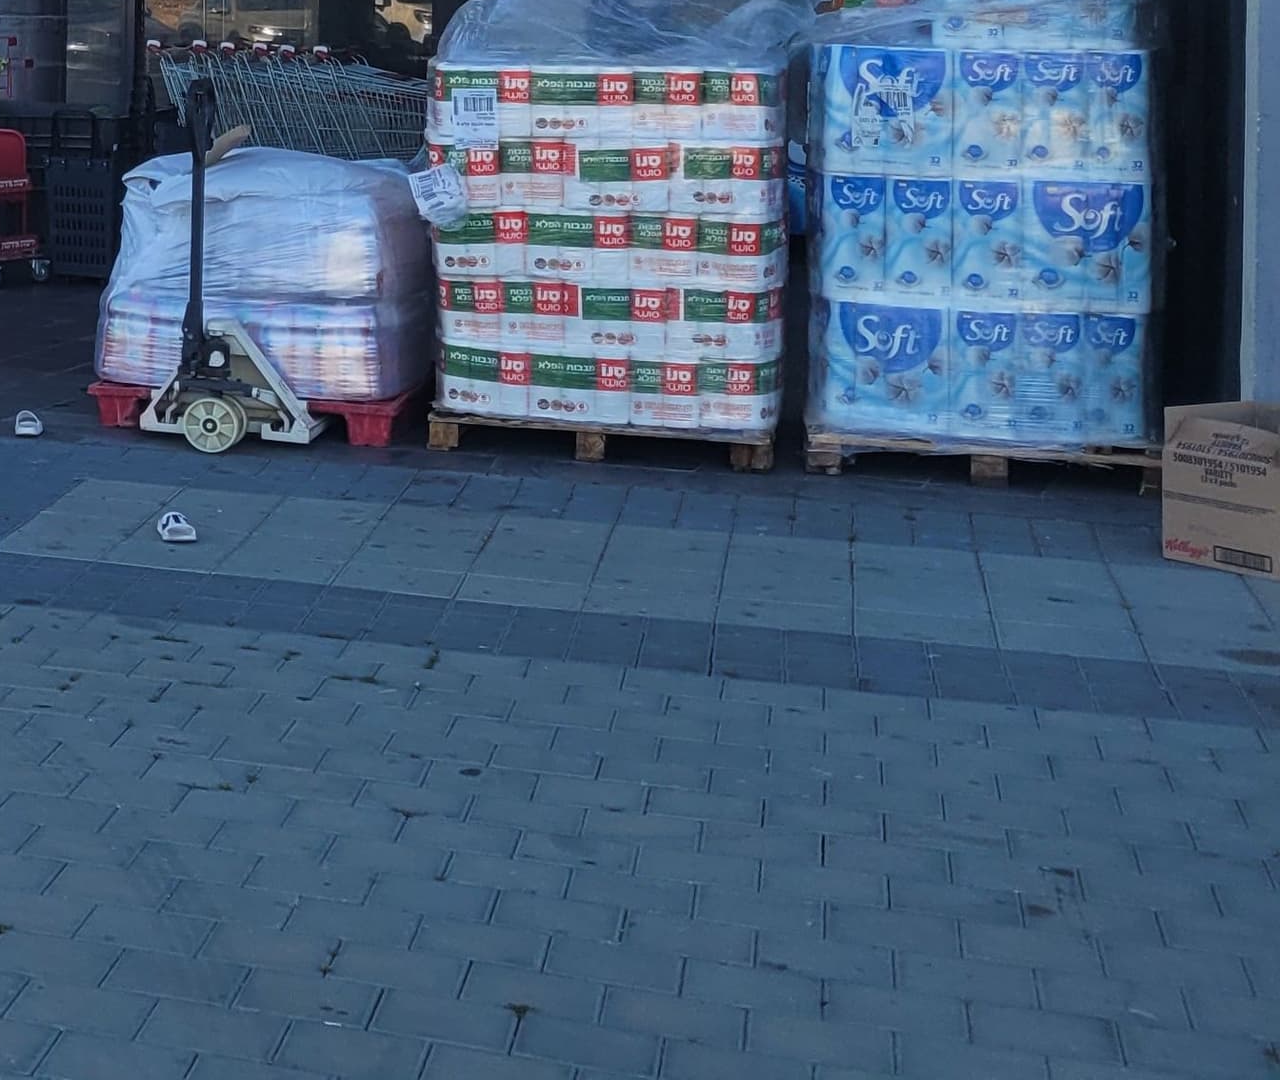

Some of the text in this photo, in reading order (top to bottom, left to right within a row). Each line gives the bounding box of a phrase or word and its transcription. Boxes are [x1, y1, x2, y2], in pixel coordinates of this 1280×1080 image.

[969, 60, 1013, 83] Soft
[1038, 60, 1079, 83] Soft
[1097, 61, 1136, 85] Soft
[839, 184, 878, 206] Soft
[901, 188, 944, 211] Soft
[968, 188, 1011, 212] Soft
[1054, 193, 1122, 239] Soft
[1128, 290, 1138, 300] 32
[856, 315, 920, 359] Soft
[966, 320, 1010, 342] Soft
[1030, 321, 1075, 345] Soft
